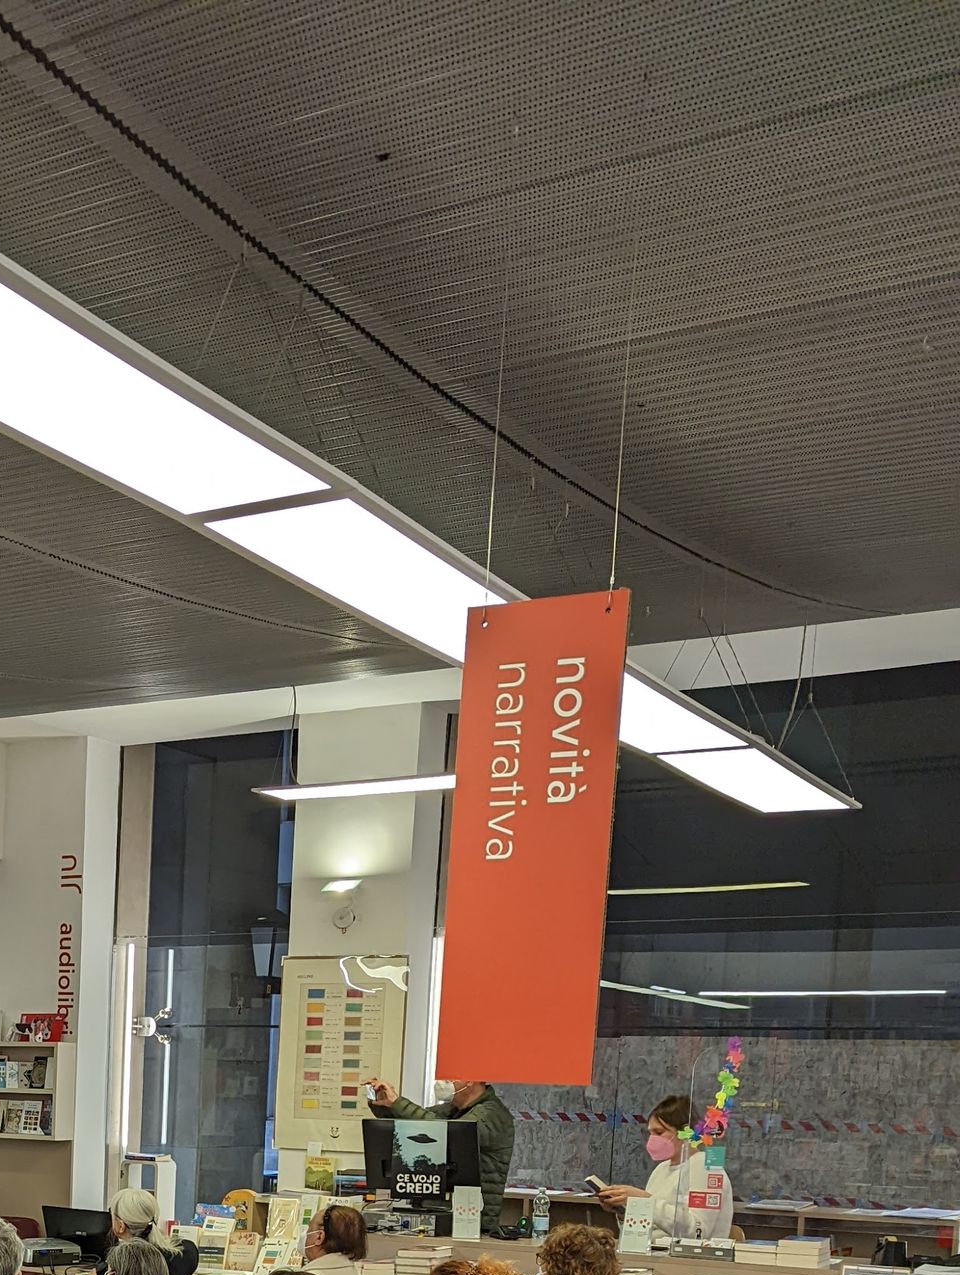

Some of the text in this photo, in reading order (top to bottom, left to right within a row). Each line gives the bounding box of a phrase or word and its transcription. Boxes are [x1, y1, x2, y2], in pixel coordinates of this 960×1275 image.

[485, 662, 527, 860] narrativa
[547, 657, 590, 804] novità
[57, 922, 75, 1035] audiolibri
[395, 1182, 440, 1194] CREDE
[396, 1173, 441, 1184] CE VOJO
